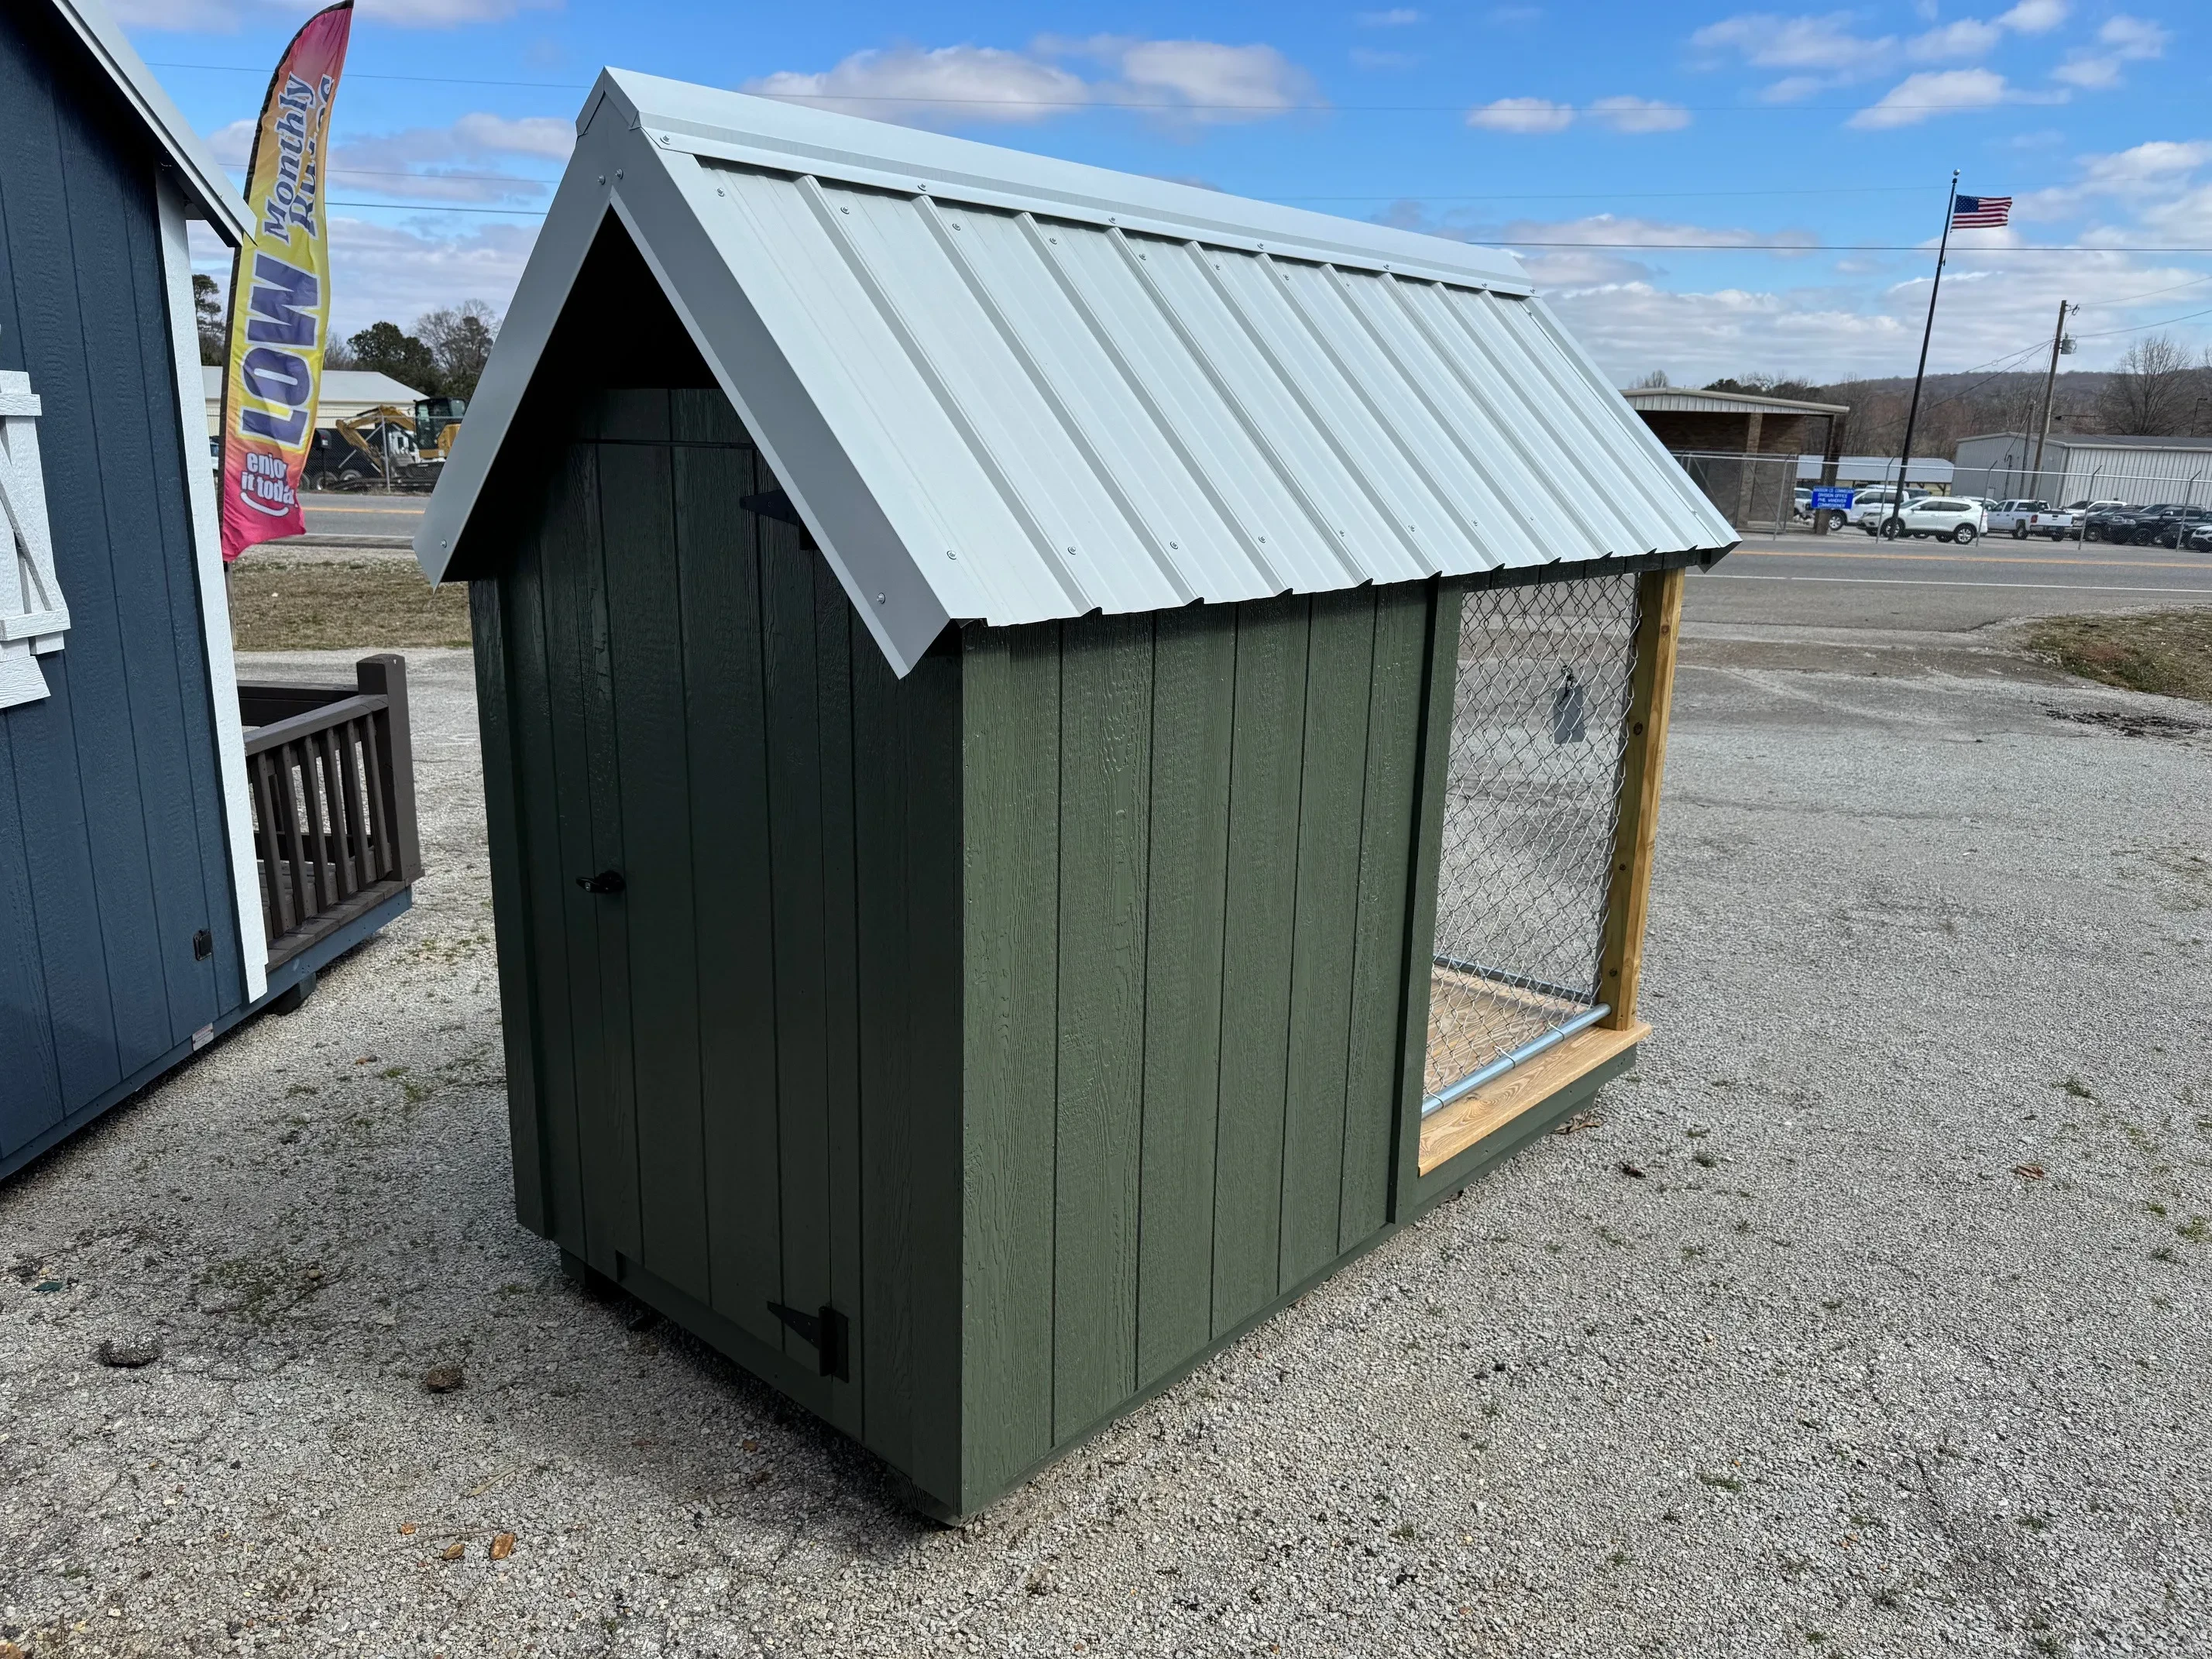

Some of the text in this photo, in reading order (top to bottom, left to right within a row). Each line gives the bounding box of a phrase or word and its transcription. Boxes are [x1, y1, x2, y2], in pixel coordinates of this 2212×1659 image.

[262, 71, 317, 247] Monthly
[239, 247, 322, 448] LOW
[241, 471, 298, 508] it toda
[246, 452, 287, 479] enjo
